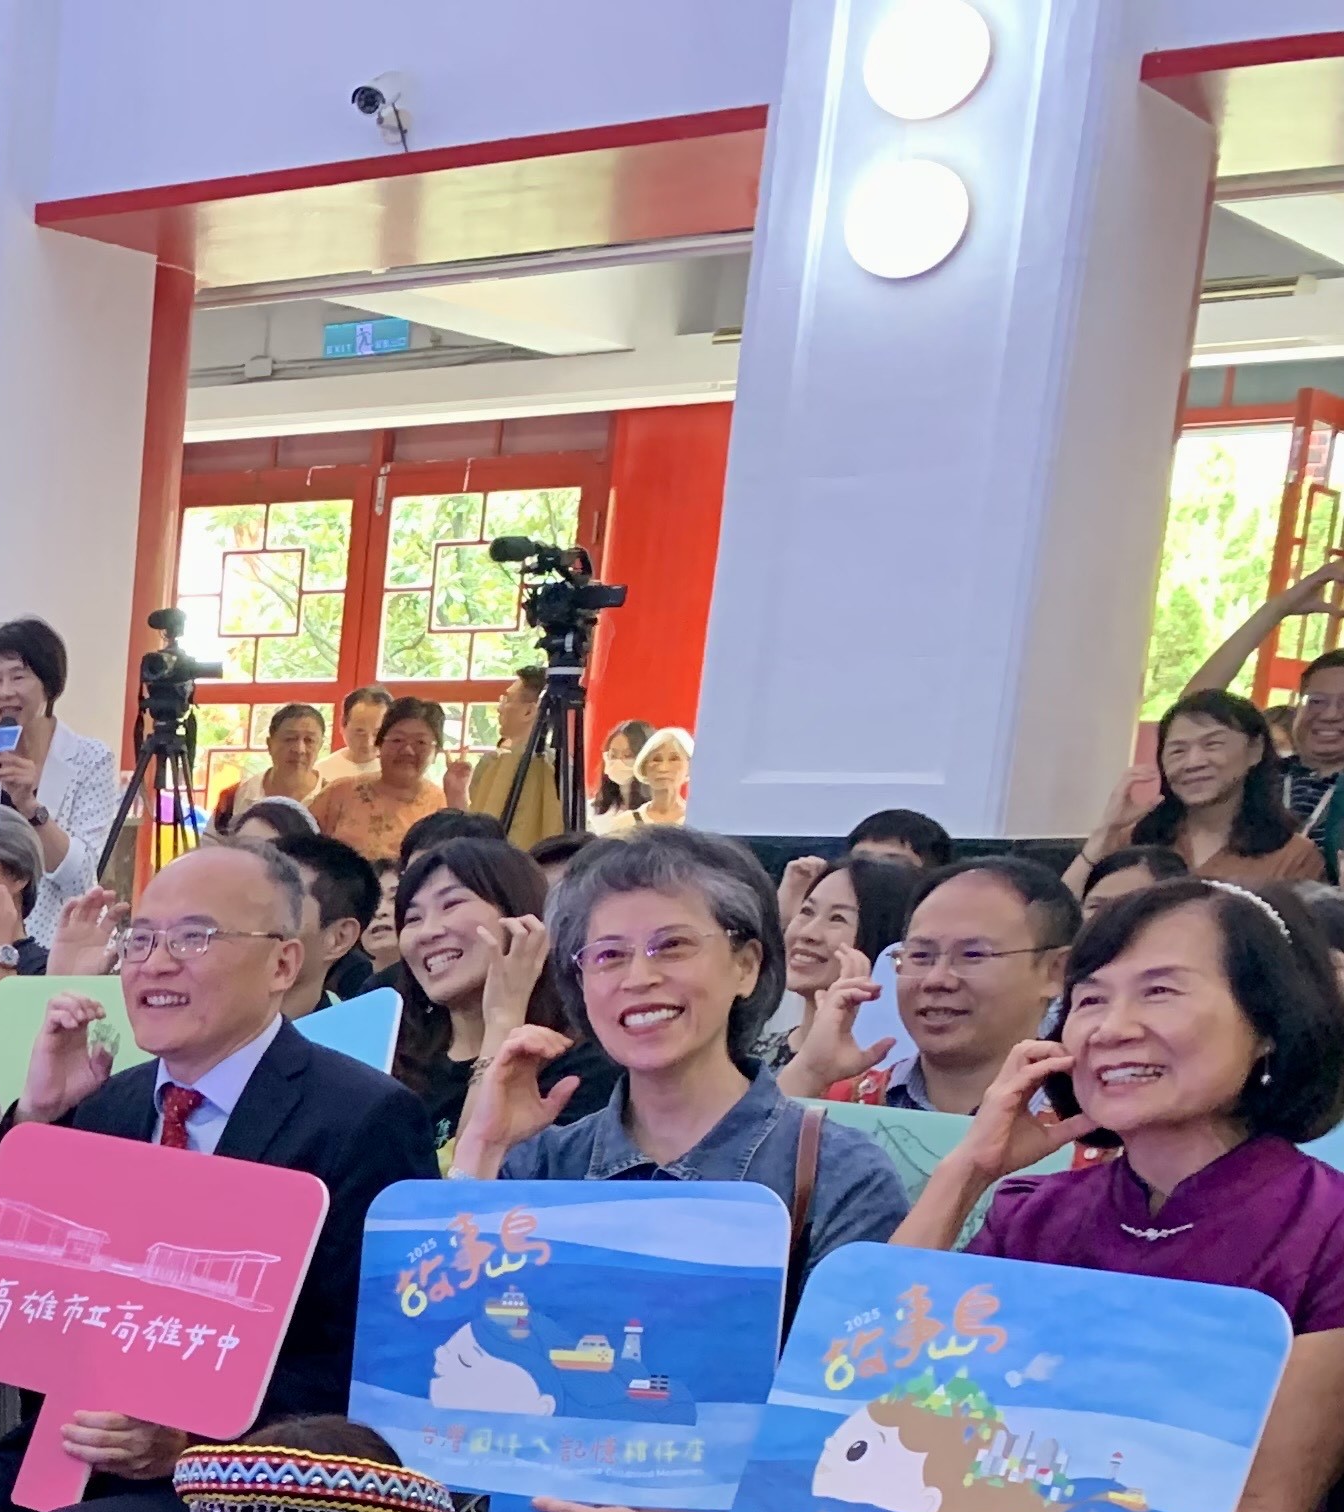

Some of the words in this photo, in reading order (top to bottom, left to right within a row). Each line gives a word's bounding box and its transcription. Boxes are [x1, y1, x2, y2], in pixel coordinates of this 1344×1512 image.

[395, 1205, 551, 1318] 故事島
[406, 1237, 438, 1264] 2025
[822, 1283, 1008, 1391] 故事島
[844, 1307, 881, 1332] 2025
